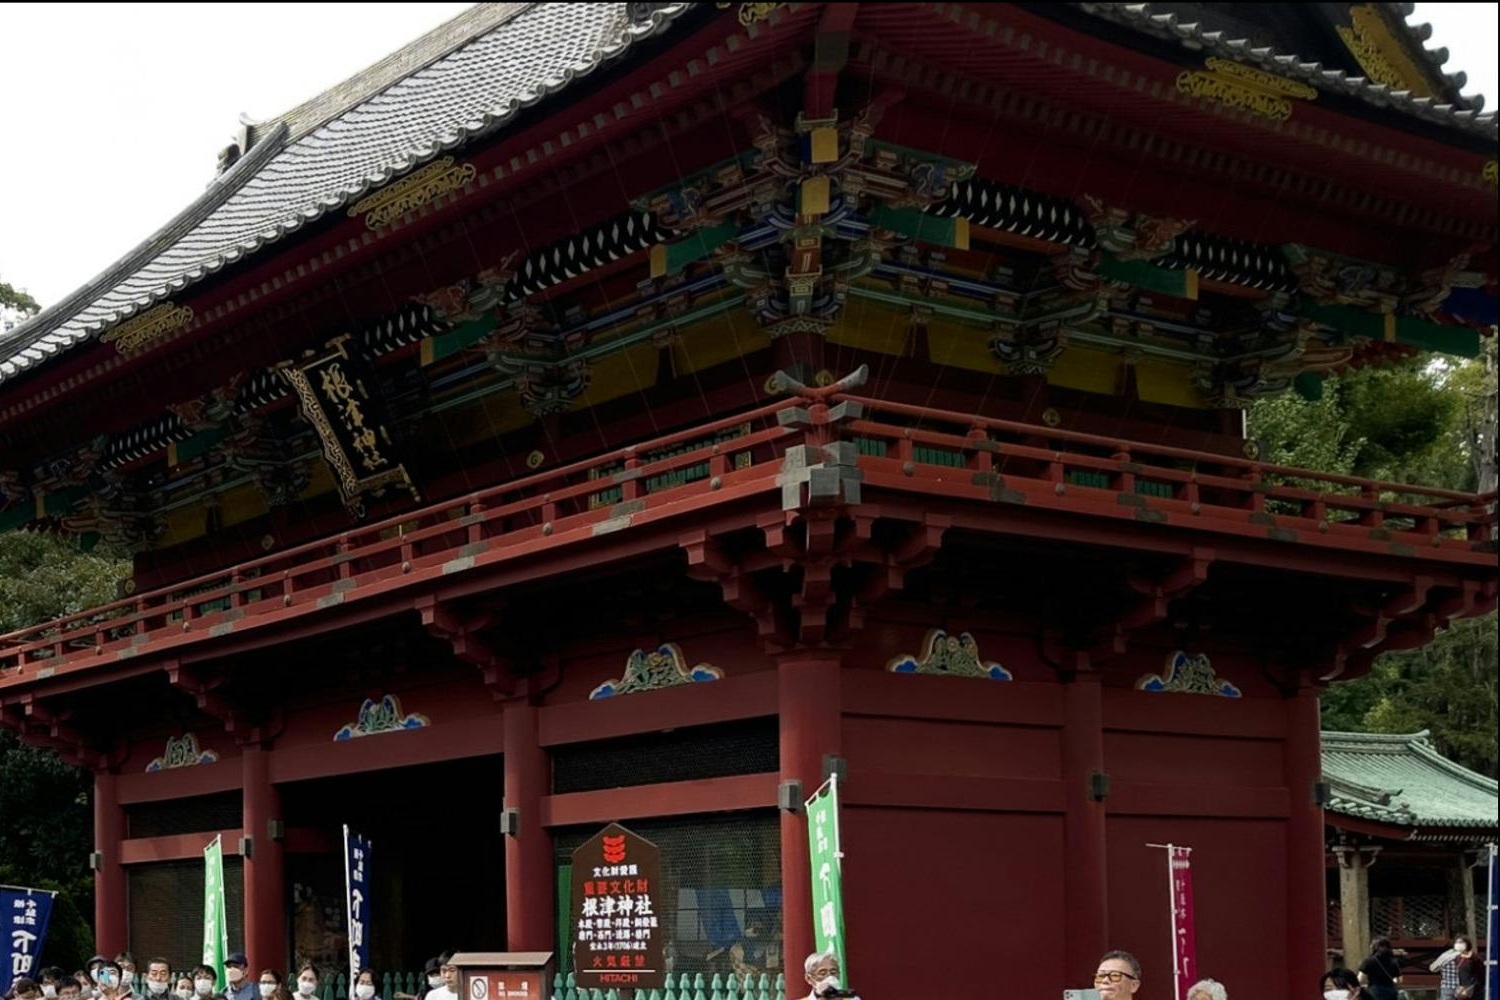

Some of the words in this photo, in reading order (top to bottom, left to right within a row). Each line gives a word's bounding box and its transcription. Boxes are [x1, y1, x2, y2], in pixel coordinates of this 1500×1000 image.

[582, 894, 653, 917] 根津神社
[600, 974, 638, 983] HITACHI
